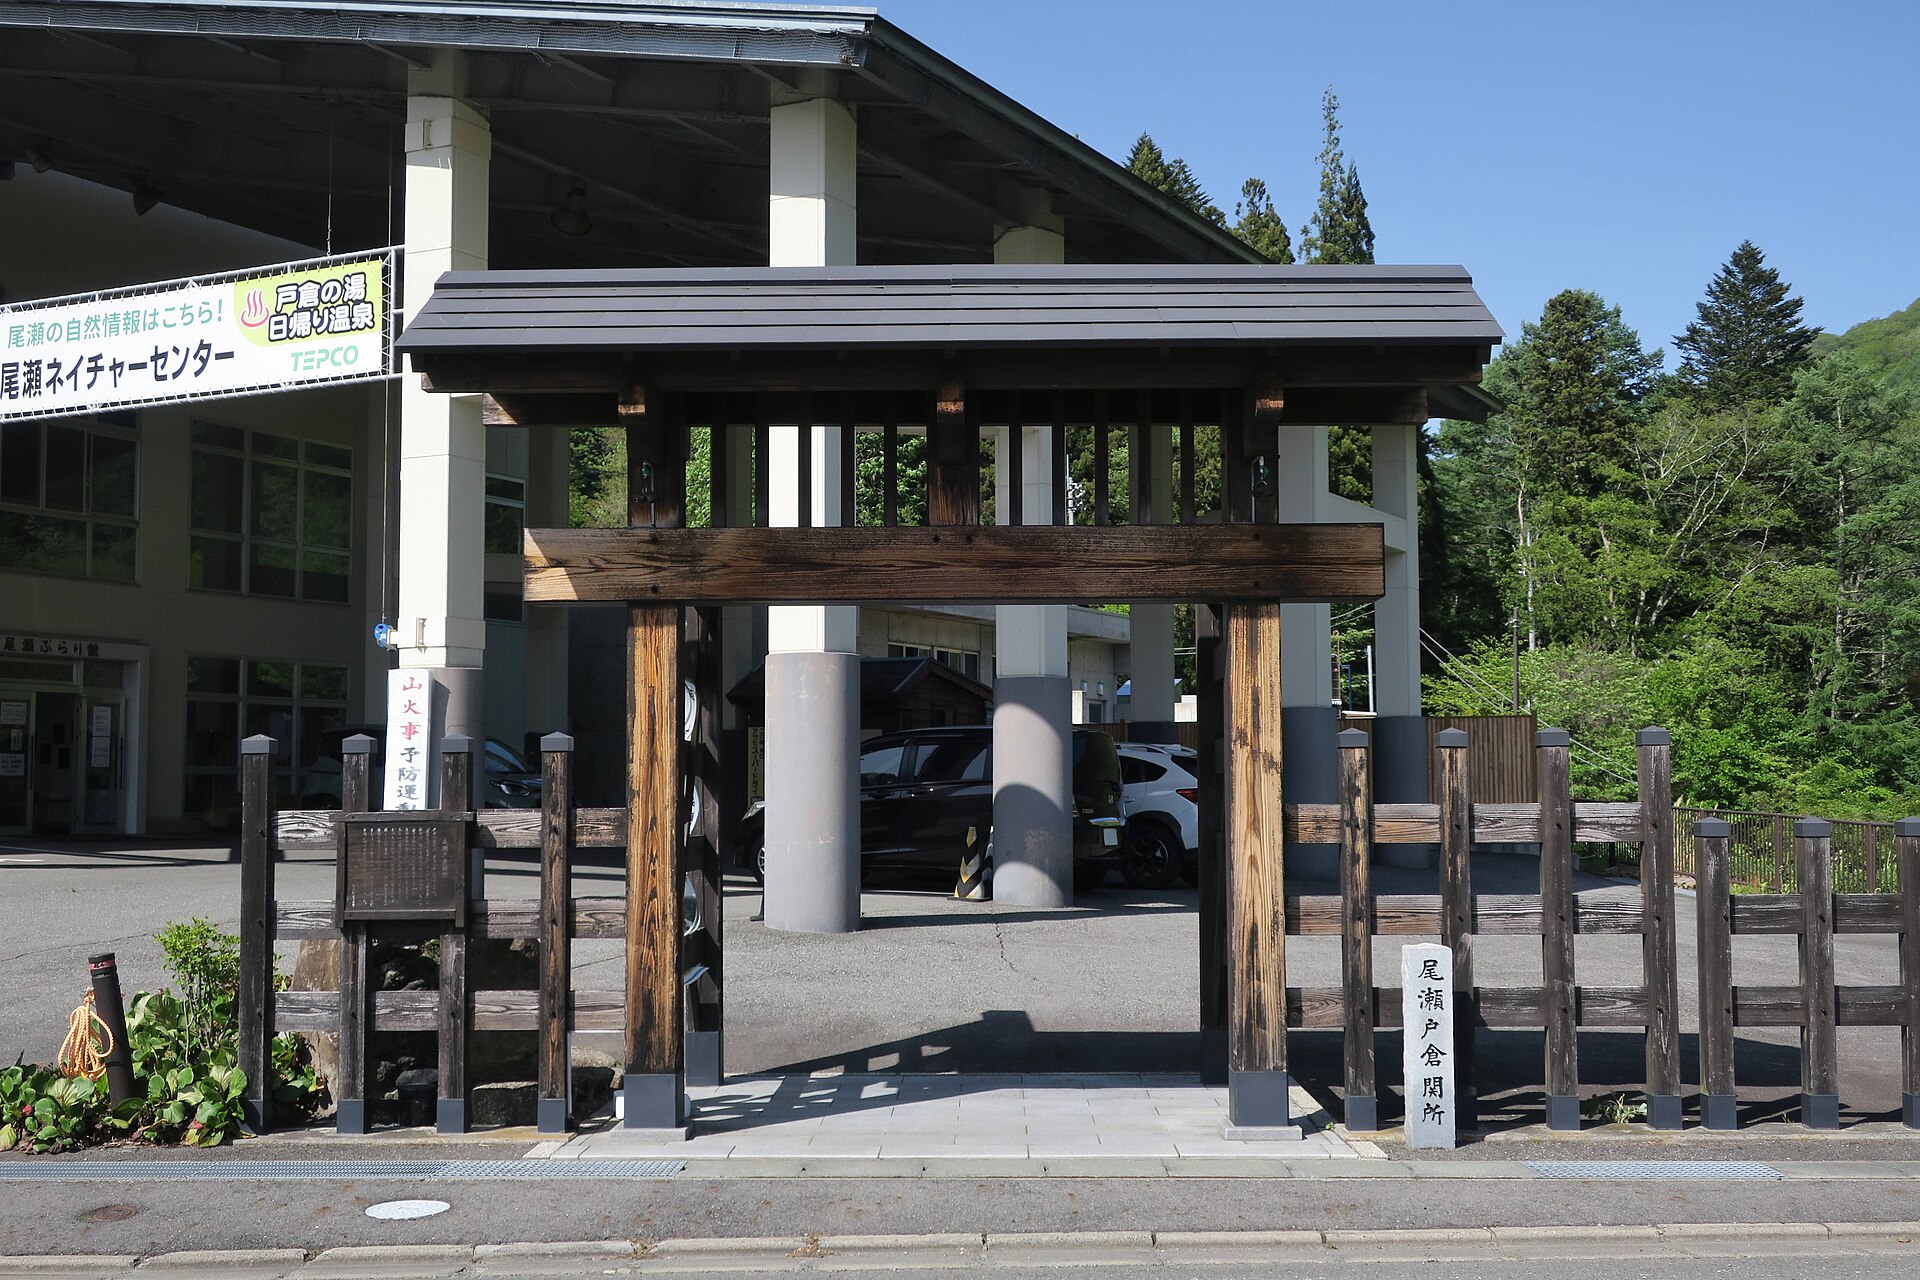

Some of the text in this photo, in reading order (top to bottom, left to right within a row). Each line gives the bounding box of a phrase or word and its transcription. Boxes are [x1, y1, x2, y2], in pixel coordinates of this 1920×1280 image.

[276, 273, 366, 312] 戸倉の湯
[268, 304, 374, 342] 日帰り温泉
[0, 339, 234, 399] 尾瀬ネイチャーセンター
[291, 346, 358, 371] TEPCO
[1418, 959, 1447, 1125] 尾瀬戸倉関所
